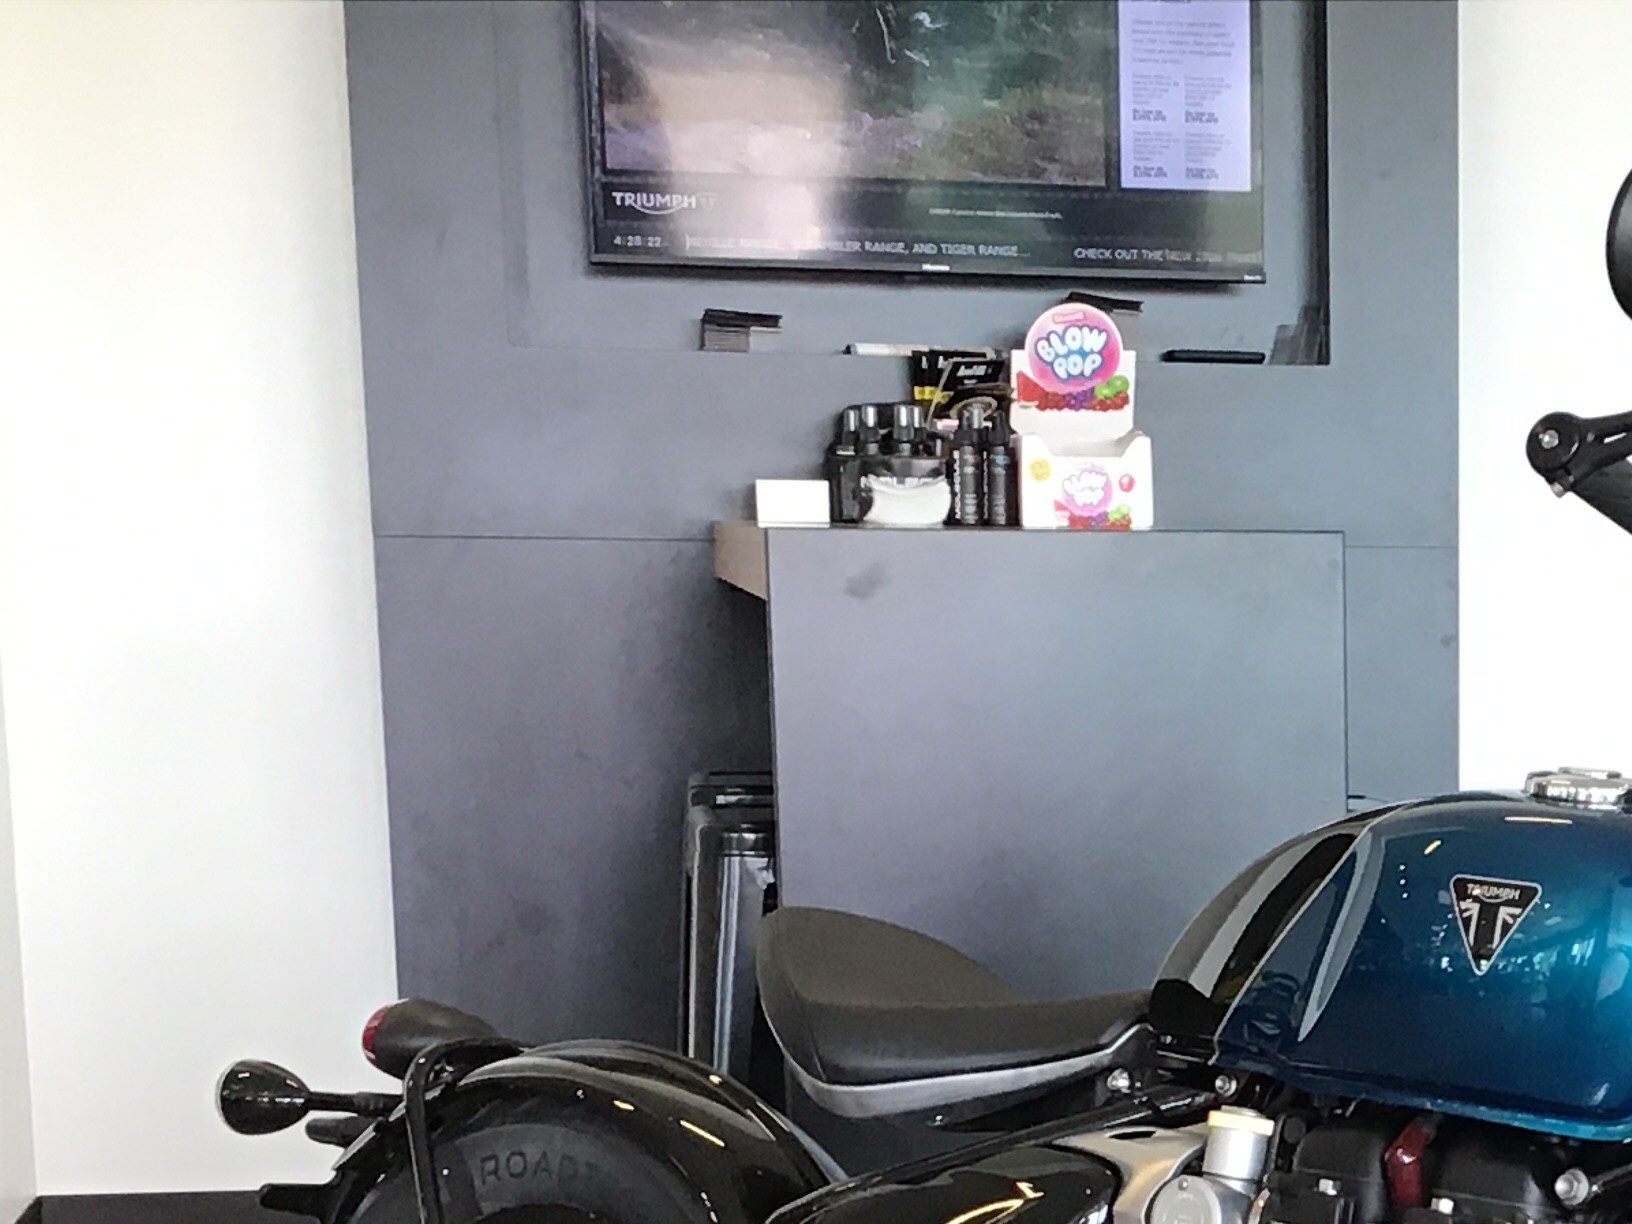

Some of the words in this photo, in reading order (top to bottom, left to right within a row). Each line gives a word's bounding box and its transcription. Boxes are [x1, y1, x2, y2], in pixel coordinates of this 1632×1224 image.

[611, 191, 697, 214] TRIUMPH
[1073, 247, 1112, 259] CHECK
[1114, 249, 1138, 260] OUT
[1035, 325, 1108, 363] BLOW
[1052, 353, 1103, 380] POP
[1466, 883, 1521, 903] TRIUMPH
